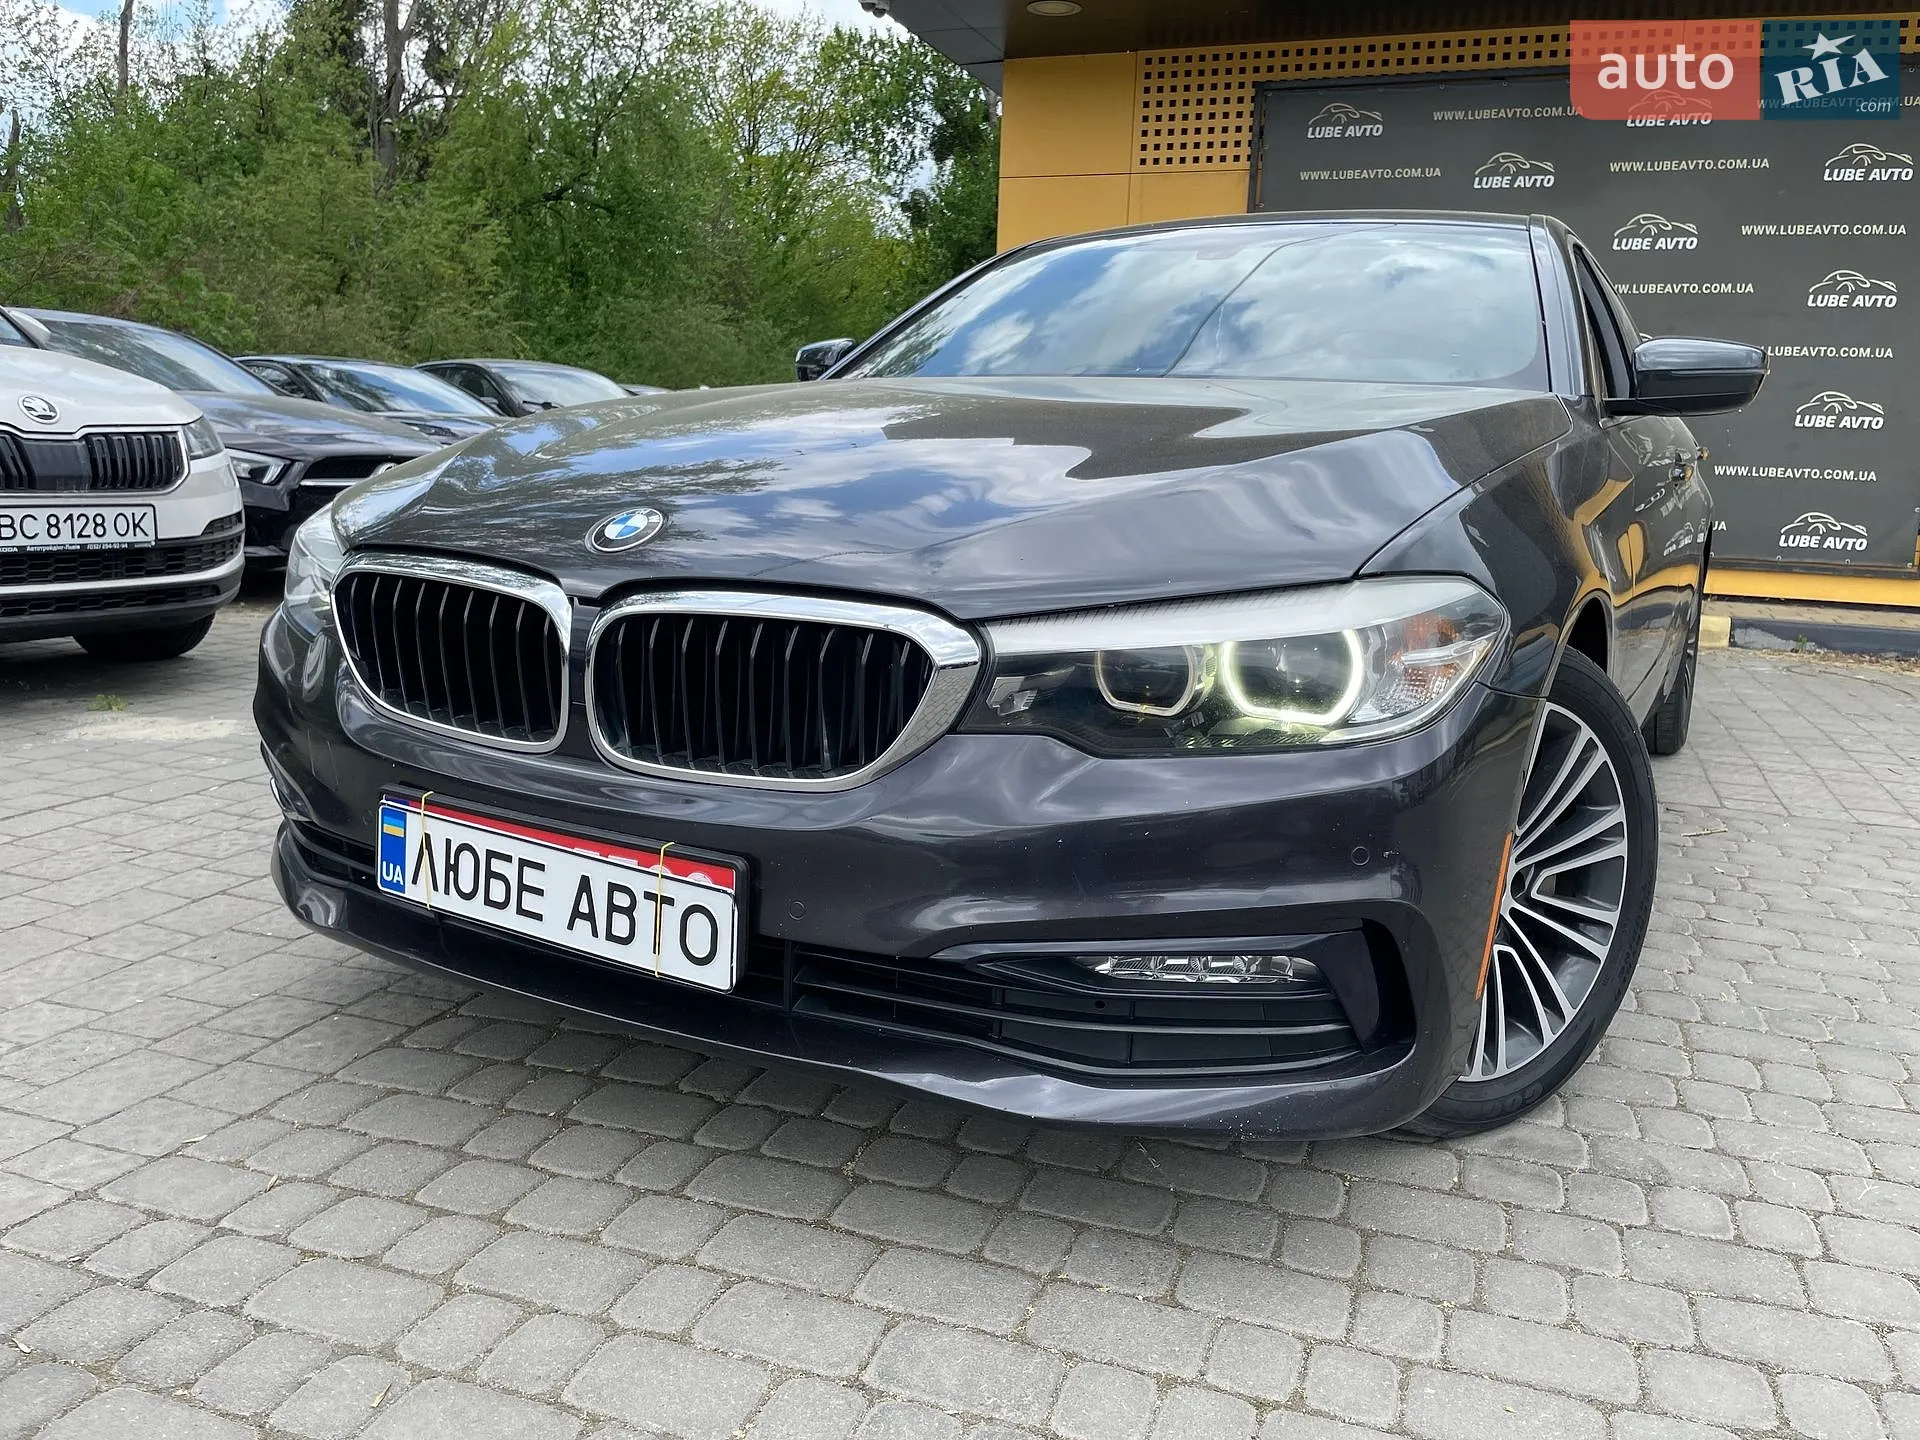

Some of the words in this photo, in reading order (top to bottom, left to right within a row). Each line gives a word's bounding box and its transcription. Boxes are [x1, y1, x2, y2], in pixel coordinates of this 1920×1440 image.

[1433, 105, 1584, 121] WWW.LUBEAVTO.COM.UA
[1626, 114, 1665, 127] LUBE
[1669, 112, 1712, 126] AVTO
[1307, 125, 1342, 139] LUBE
[1345, 124, 1383, 137] AVTO
[1610, 158, 1770, 172] WWW.LUBEAVTO.COM.UA
[1300, 168, 1441, 180] WWW.LUBEAVTO.COM.UA
[1473, 175, 1512, 188] LUBE
[1514, 174, 1554, 188] AVTO
[1824, 168, 1865, 181] LUBE
[1868, 168, 1914, 181] AVTO
[1742, 224, 1907, 235] WWW.LUBEAVTO.COM.UA
[1612, 237, 1652, 250] LUBE
[1655, 236, 1698, 250] AVTO
[1807, 294, 1849, 307] LUBE
[1852, 295, 1897, 308] AVTO
[1761, 346, 1894, 359] LUBEAVTO.COM.UA
[1795, 414, 1837, 428] LUBE
[1839, 415, 1884, 430] AVTO
[1714, 465, 1877, 482] WWW.LUBEAVTO.COM.UA
[46, 513, 107, 539] 8128
[114, 512, 149, 537] OK
[1779, 534, 1820, 548] LUBE
[1823, 535, 1868, 551] AVTO
[382, 859, 404, 886] UA
[411, 832, 546, 922] ЛЮБЕ
[567, 874, 718, 966] АВТО
